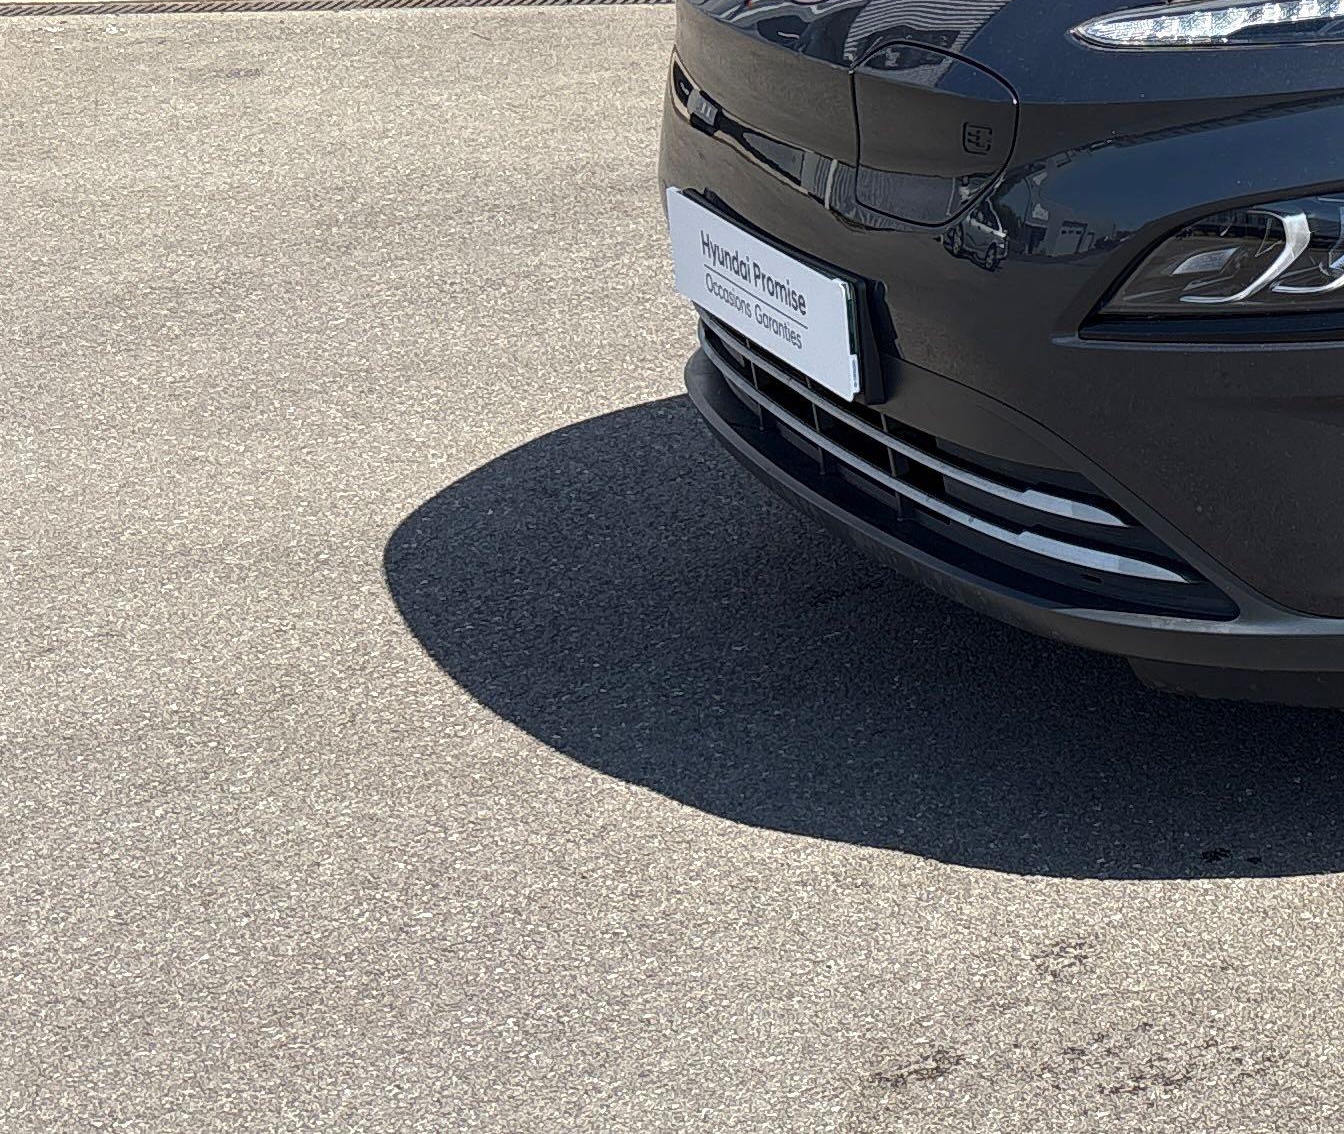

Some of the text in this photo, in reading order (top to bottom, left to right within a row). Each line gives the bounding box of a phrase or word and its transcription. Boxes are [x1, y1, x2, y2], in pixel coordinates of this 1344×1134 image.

[700, 229, 807, 316] Hyundai Promise
[705, 272, 803, 350] Occasions Garanties
